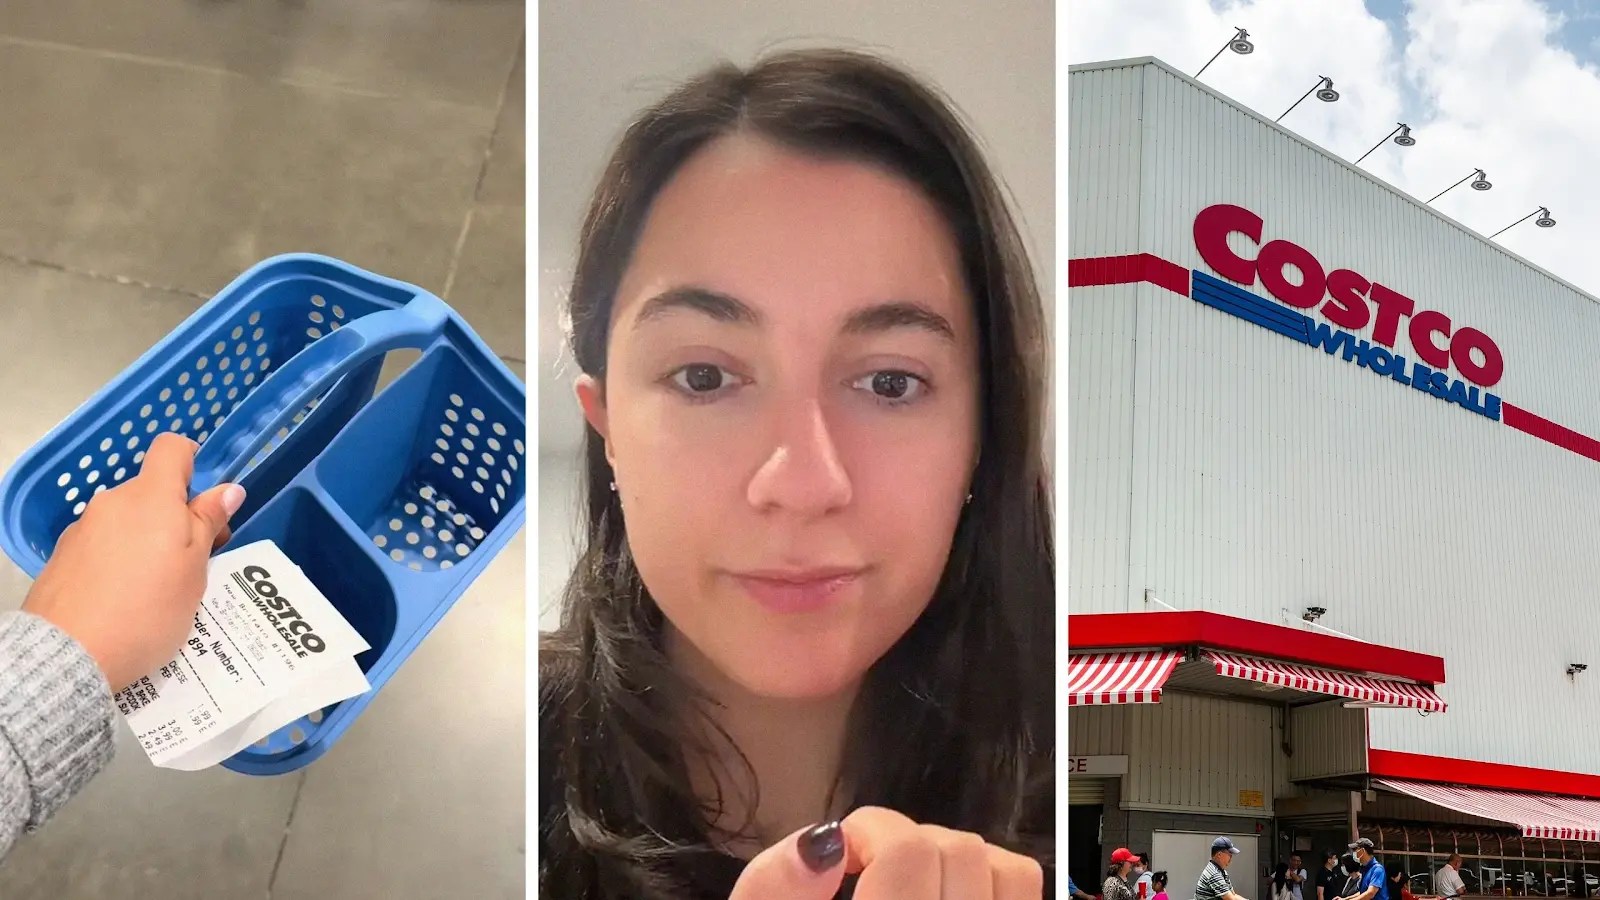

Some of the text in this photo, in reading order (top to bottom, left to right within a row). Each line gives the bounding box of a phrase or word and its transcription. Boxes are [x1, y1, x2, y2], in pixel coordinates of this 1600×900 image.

[1193, 203, 1504, 387] COSTCO
[1303, 315, 1501, 421] WHOLESALE
[223, 584, 236, 600] New
[239, 603, 269, 639] Britain
[272, 643, 296, 671] #1196
[243, 565, 326, 653] COSTCO
[252, 597, 308, 659] WHOLESALE
[159, 666, 172, 679] PEP
[168, 660, 188, 684] CHEESE
[187, 637, 208, 657] 894
[194, 611, 243, 683] rder Number:
[118, 703, 131, 716] SUN
[138, 733, 153, 750] 2.49
[135, 689, 151, 707] BAKE
[158, 724, 173, 741] 3.99
[147, 729, 163, 746] 2.49
[167, 719, 183, 736] 3.00
